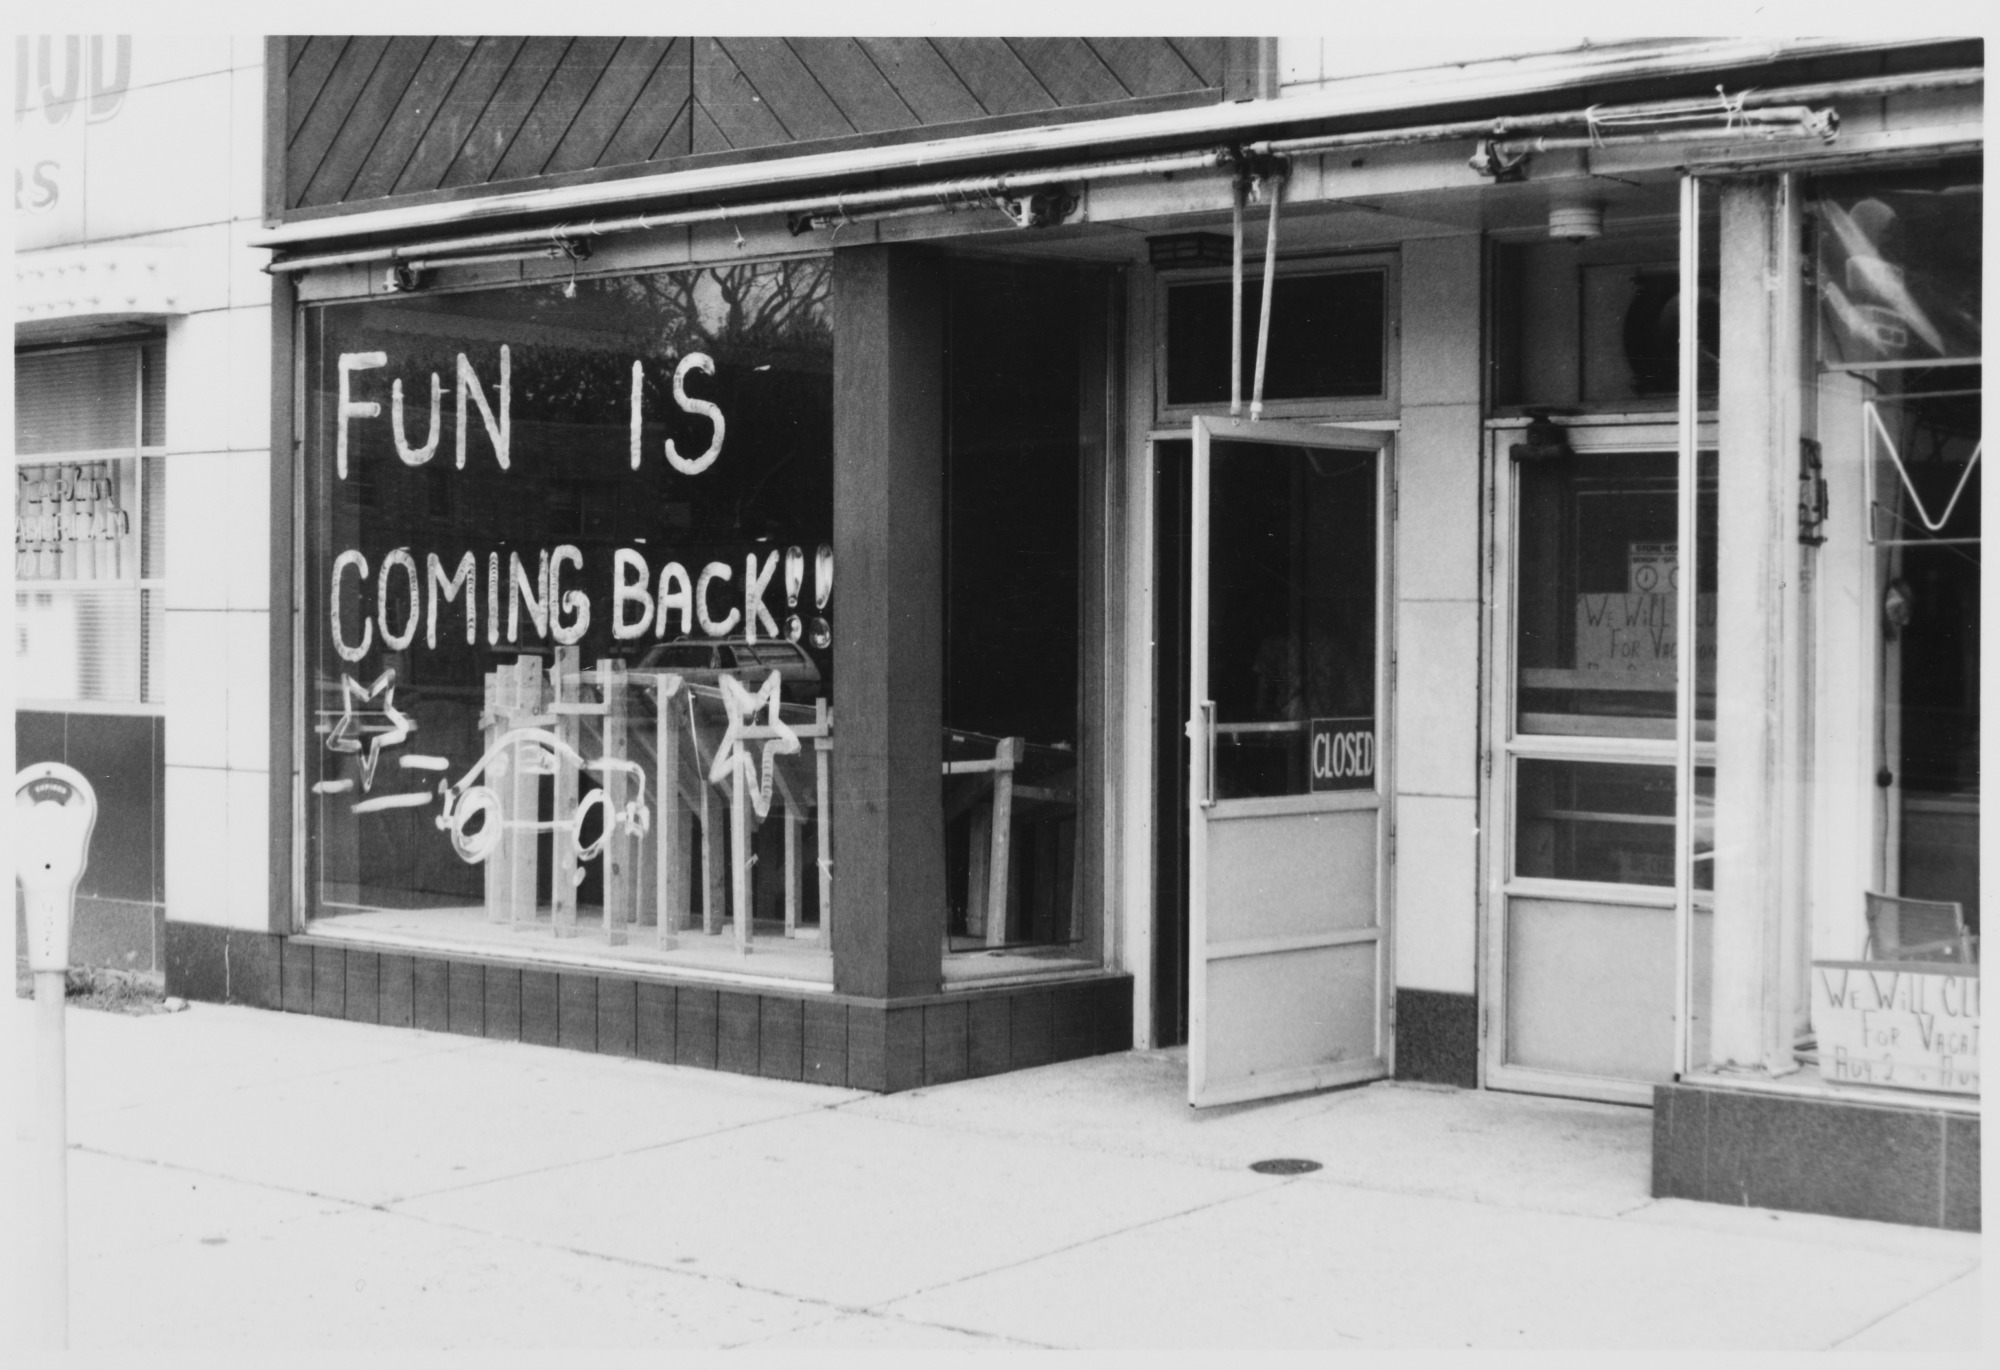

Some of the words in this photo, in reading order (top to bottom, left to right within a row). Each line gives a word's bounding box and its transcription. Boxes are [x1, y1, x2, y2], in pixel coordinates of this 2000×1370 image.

[337, 344, 511, 480] FUN
[631, 352, 726, 475] IS
[331, 545, 590, 662] COMING
[612, 543, 834, 649] BACK!!
[1584, 593, 1614, 627] WE
[1610, 627, 1641, 659] FOR
[1313, 731, 1374, 778] CLOSED
[1821, 968, 1861, 1010] WE
[1862, 1009, 1900, 1048] FOR
